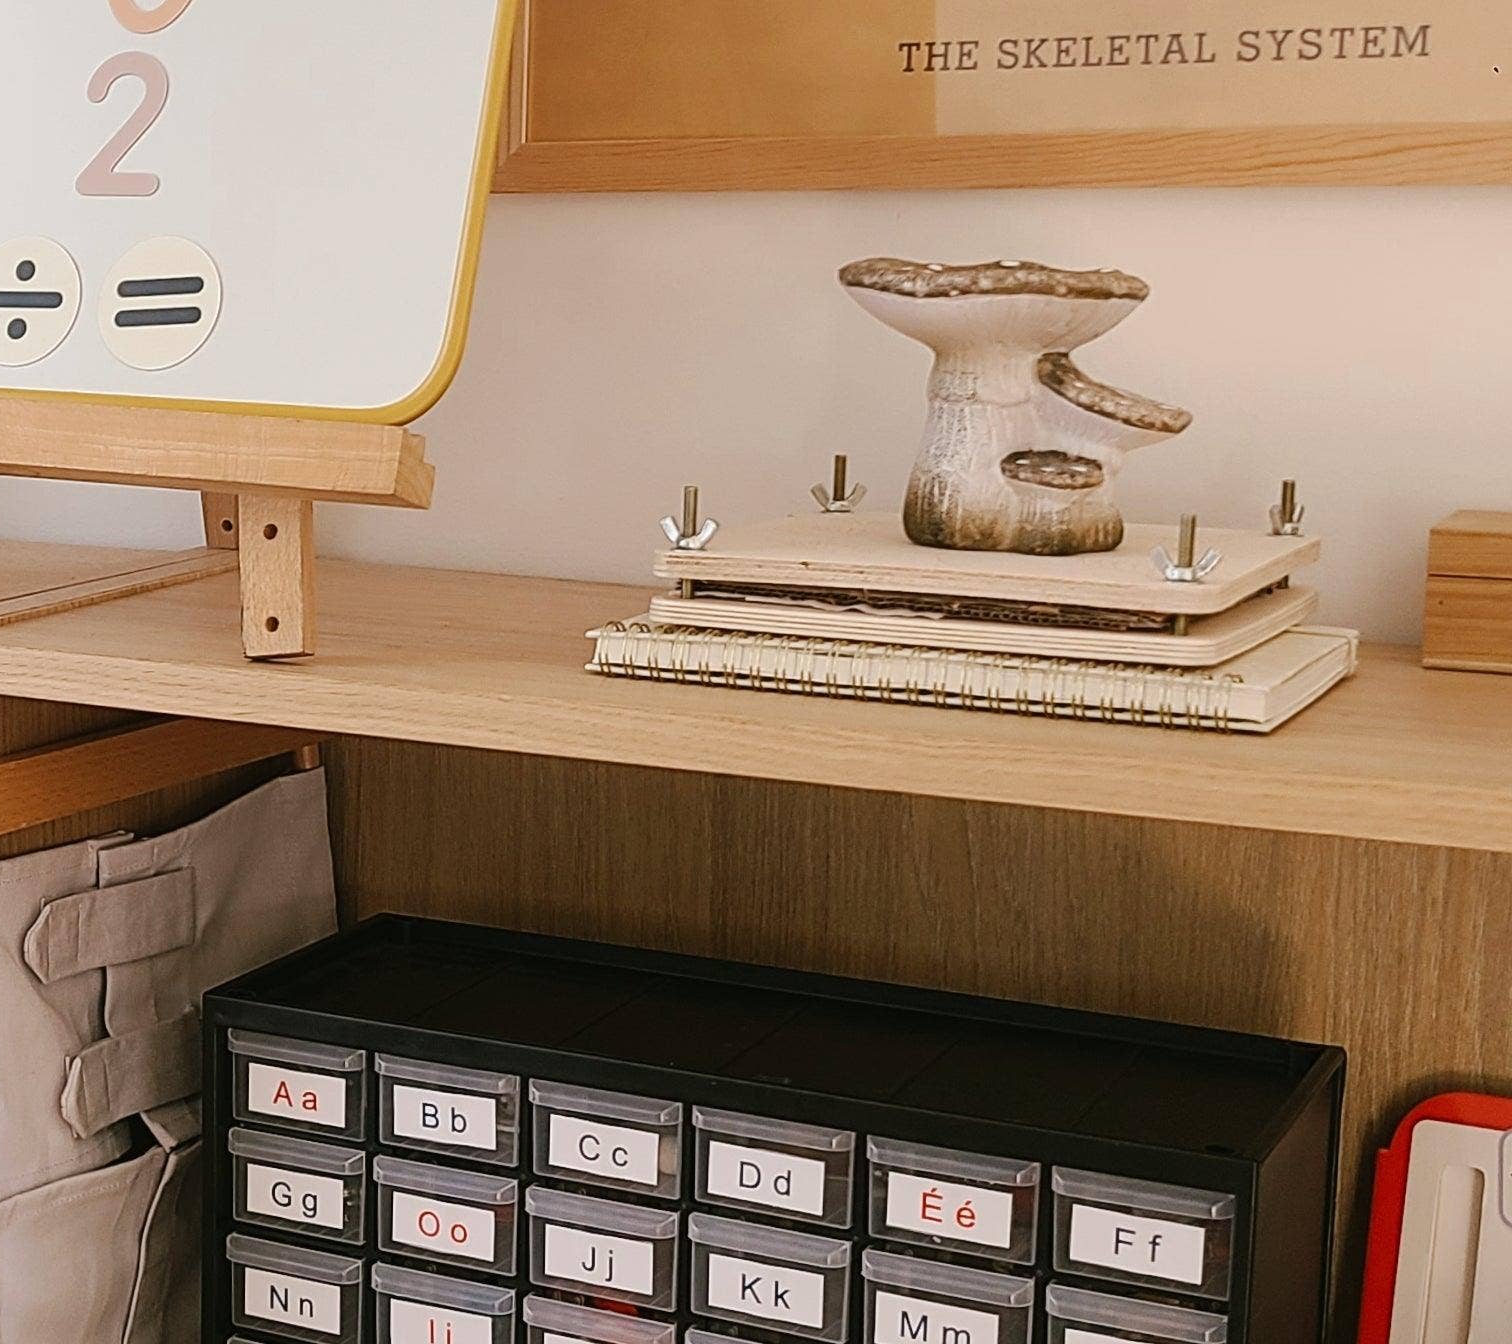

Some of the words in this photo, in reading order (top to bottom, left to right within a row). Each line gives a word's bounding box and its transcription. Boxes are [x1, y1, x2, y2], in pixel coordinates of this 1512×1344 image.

[899, 40, 979, 73] THE
[996, 32, 1217, 70] SKELETAL
[1236, 25, 1431, 63] SYSTEM
[75, 50, 169, 197] 2
